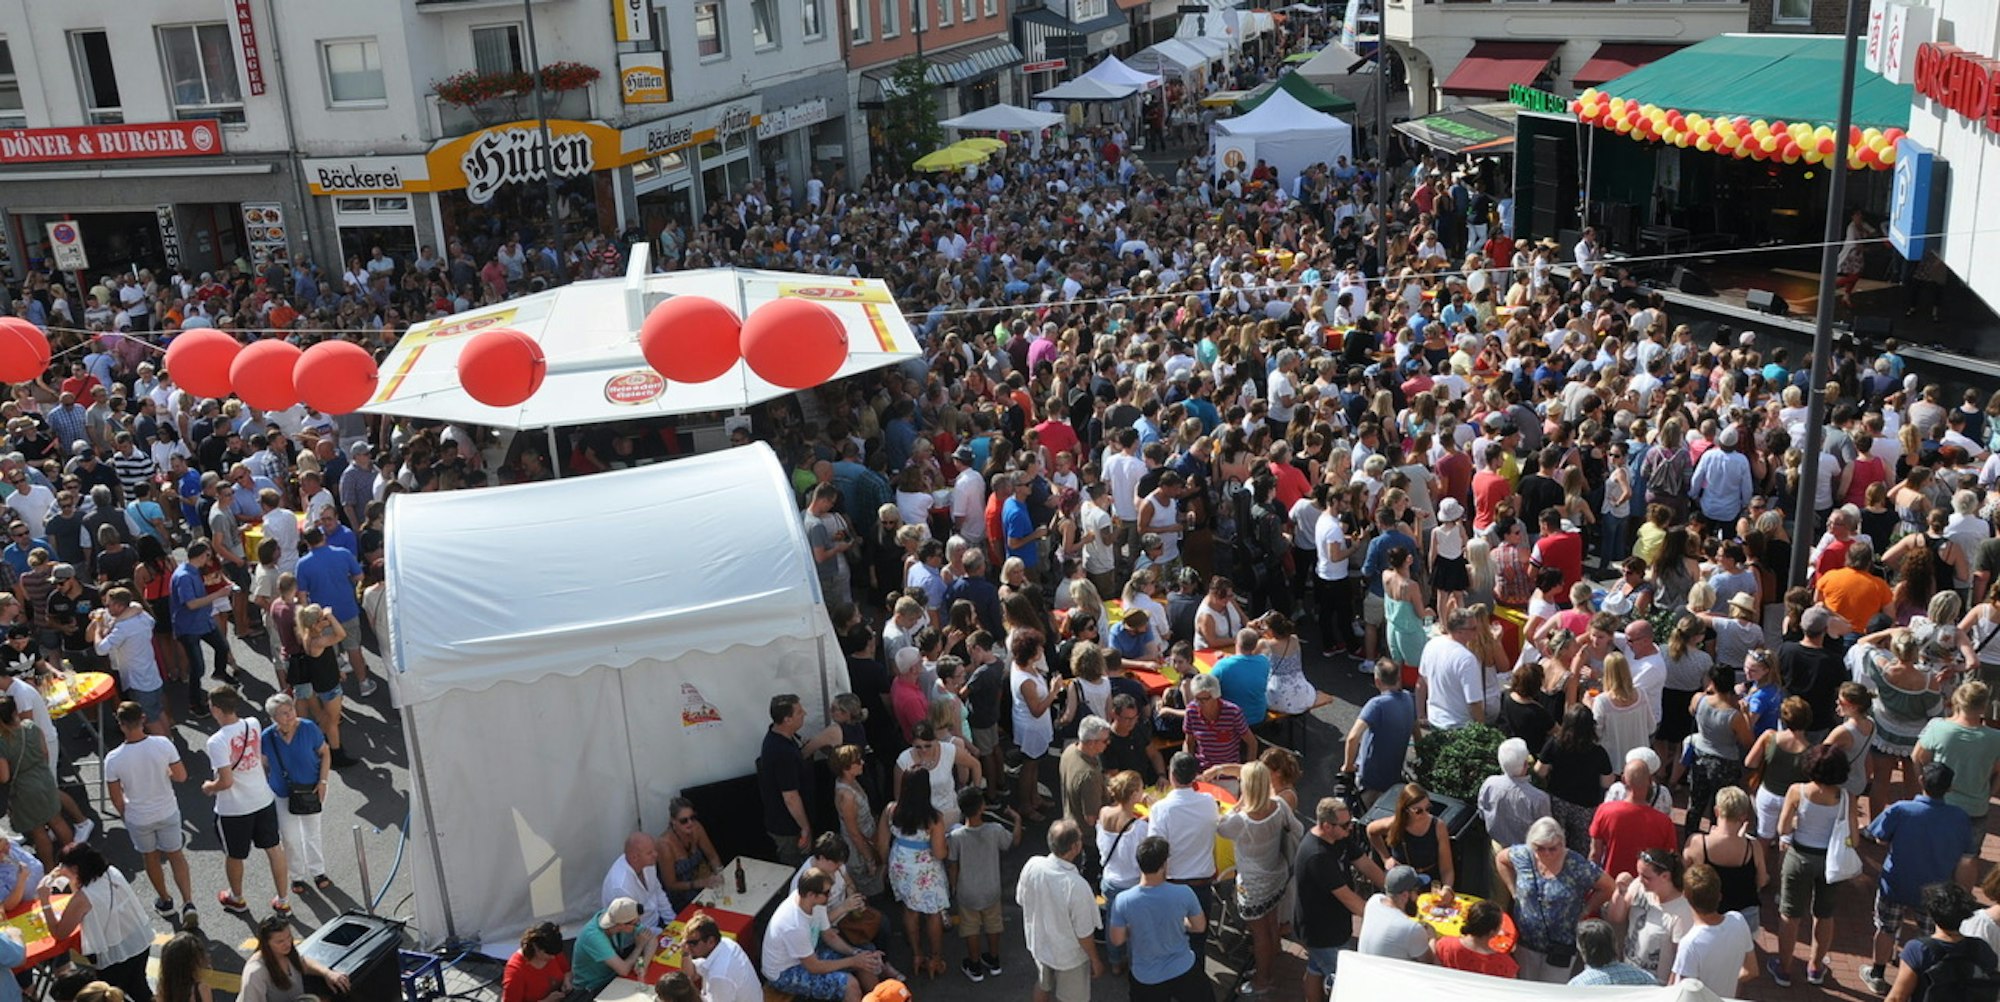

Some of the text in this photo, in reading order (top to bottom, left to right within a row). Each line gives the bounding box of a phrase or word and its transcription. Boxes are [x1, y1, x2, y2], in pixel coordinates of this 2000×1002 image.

[241, 23, 264, 94] BURGER
[1, 129, 188, 157] DÖNER & BURGER
[648, 121, 693, 152] Bäckerei
[318, 164, 400, 188] Bäckerei
[466, 133, 589, 200] Hüten
